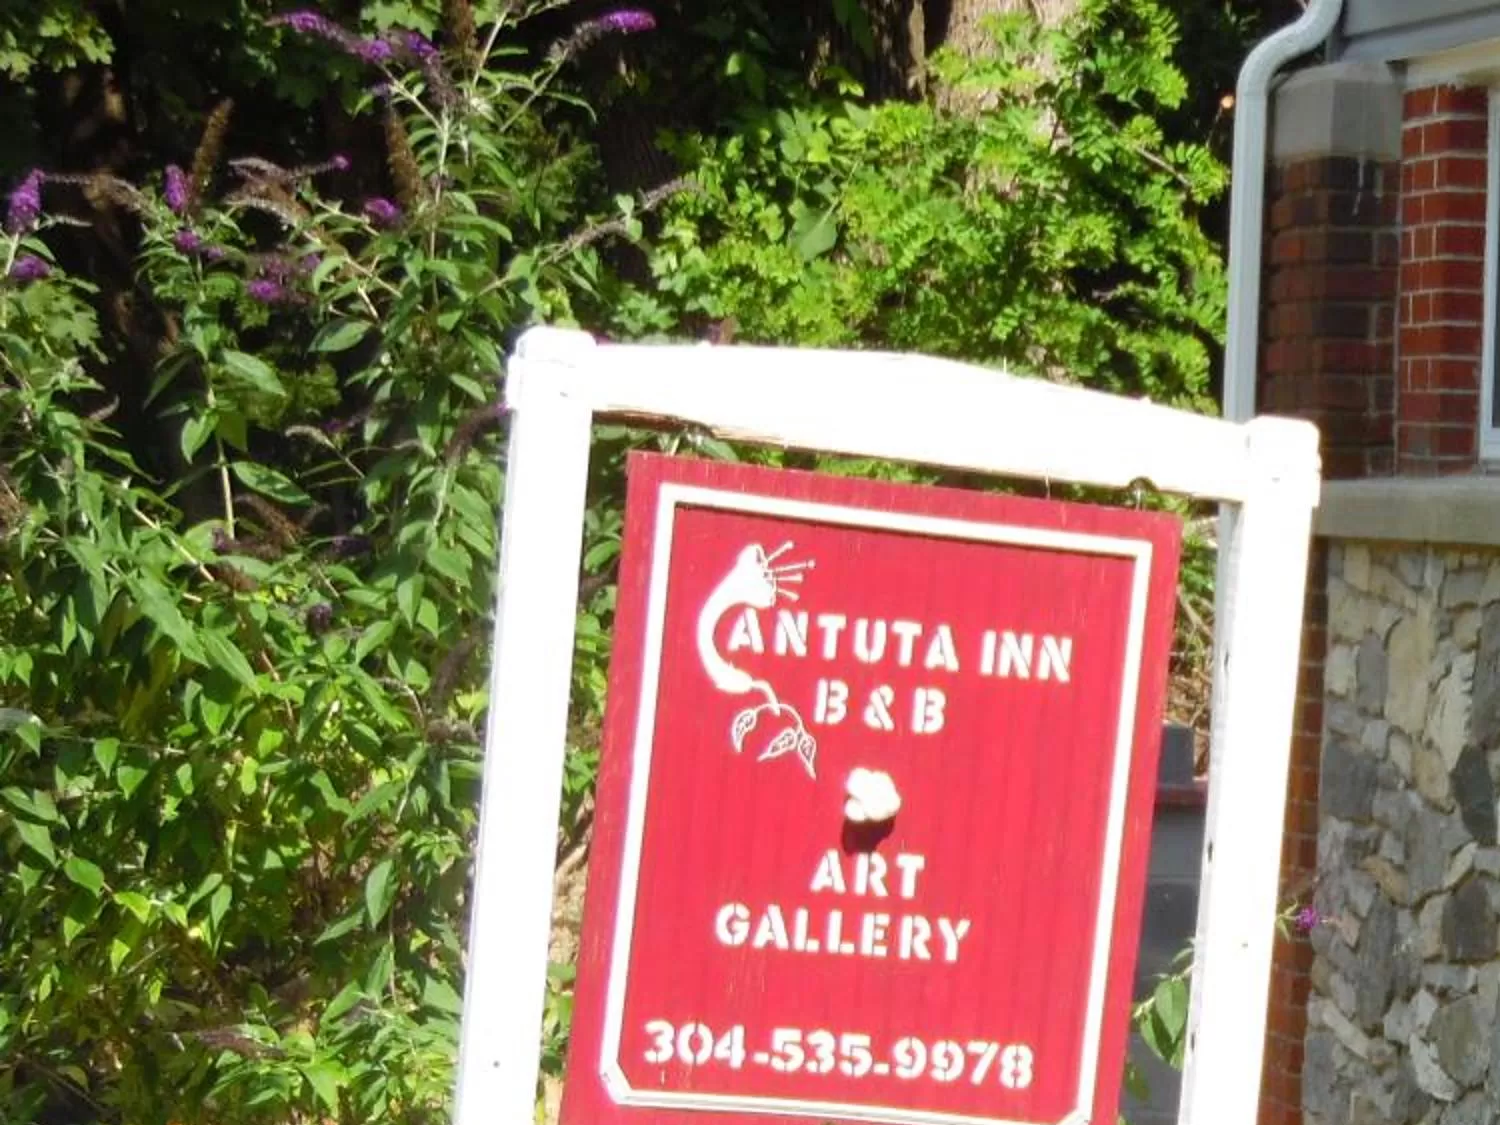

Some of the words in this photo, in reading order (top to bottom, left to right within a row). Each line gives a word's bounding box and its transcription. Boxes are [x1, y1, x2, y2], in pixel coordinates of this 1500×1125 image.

[980, 630, 1073, 683] INN
[810, 849, 925, 900] ART
[715, 903, 971, 963] GALLERY
[644, 1018, 1034, 1089] 304-535-9978
